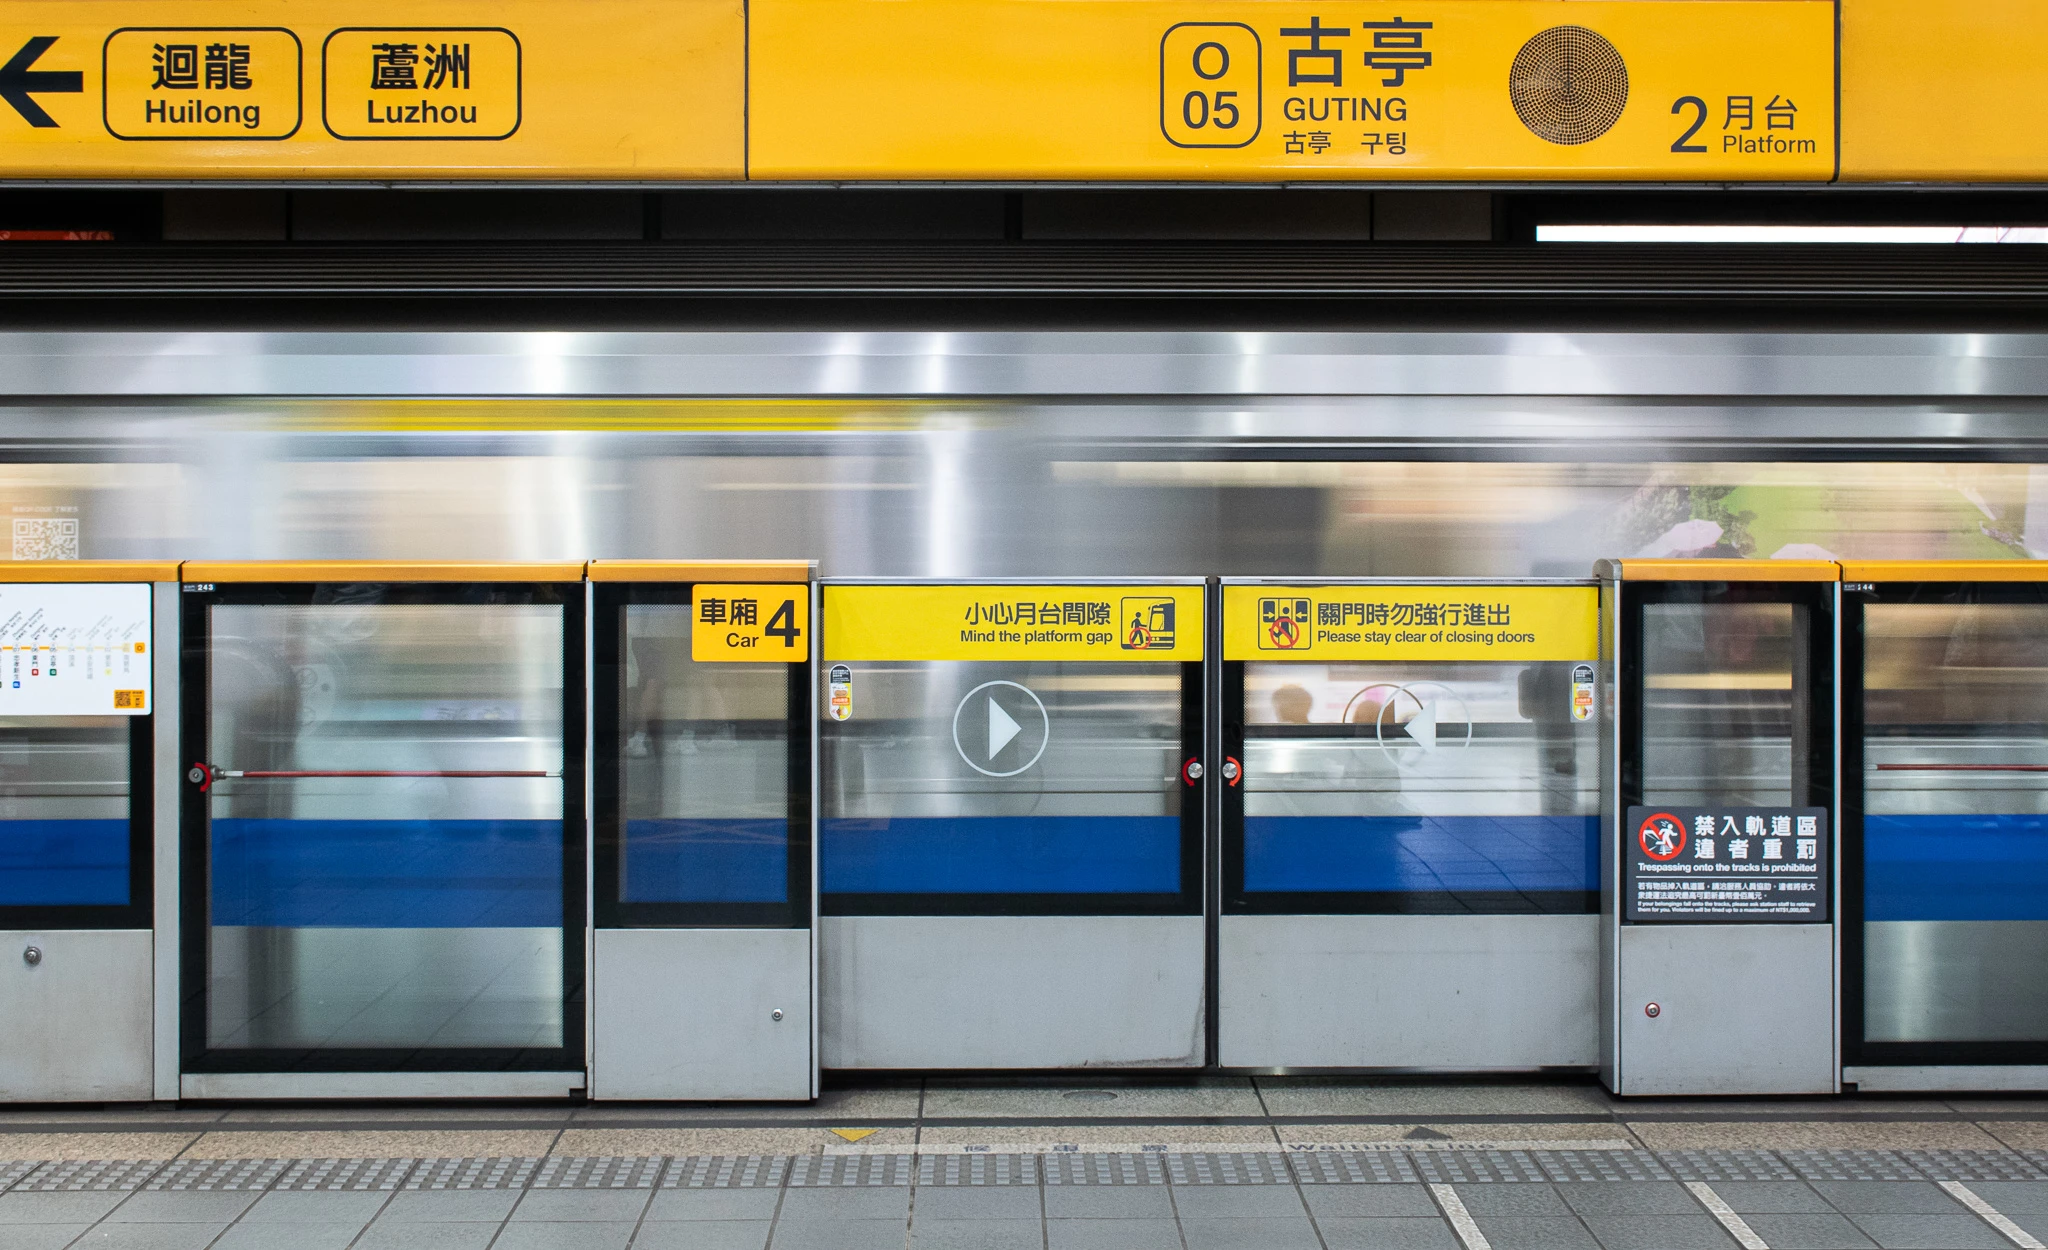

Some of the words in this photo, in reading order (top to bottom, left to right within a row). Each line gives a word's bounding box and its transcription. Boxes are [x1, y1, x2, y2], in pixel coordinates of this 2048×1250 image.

[1193, 42, 1230, 81] O
[1280, 17, 1434, 88] 古亭
[151, 43, 253, 90] 迴龍
[371, 43, 470, 90] 蘆洲
[146, 100, 260, 129] Huilong
[368, 100, 477, 123] Luzhou
[1183, 91, 1240, 130] 05
[1284, 98, 1407, 121] GUTING
[1723, 95, 1798, 130] 月台
[1671, 96, 1708, 152] 2
[1283, 131, 1332, 155] 古亭
[1361, 132, 1406, 156] 구팅
[1724, 135, 1816, 153] Platform
[700, 598, 758, 626] 車廂
[765, 600, 801, 648] 4
[965, 602, 1112, 626] 小心月台間隙
[1318, 603, 1510, 627] 關門時勿強行進出
[727, 633, 760, 648] Car
[961, 630, 994, 642] Mind
[999, 630, 1020, 642] the
[1025, 630, 1082, 646] platform
[1087, 633, 1113, 646] gap
[1318, 631, 1361, 643] Please
[1365, 632, 1391, 646] stay
[1395, 631, 1426, 643] clear
[1430, 631, 1443, 643] of
[1446, 631, 1493, 646] closing
[1497, 631, 1535, 643] doors
[1694, 815, 1817, 837] 禁入軌道區
[1694, 838, 1817, 860] 違者重罰
[1638, 862, 1691, 873] Trespassing
[1693, 863, 1714, 872] onto
[1715, 863, 1731, 872] the
[1732, 863, 1760, 872] tracks
[1762, 863, 1770, 872] is
[1771, 863, 1817, 874] prohibited
